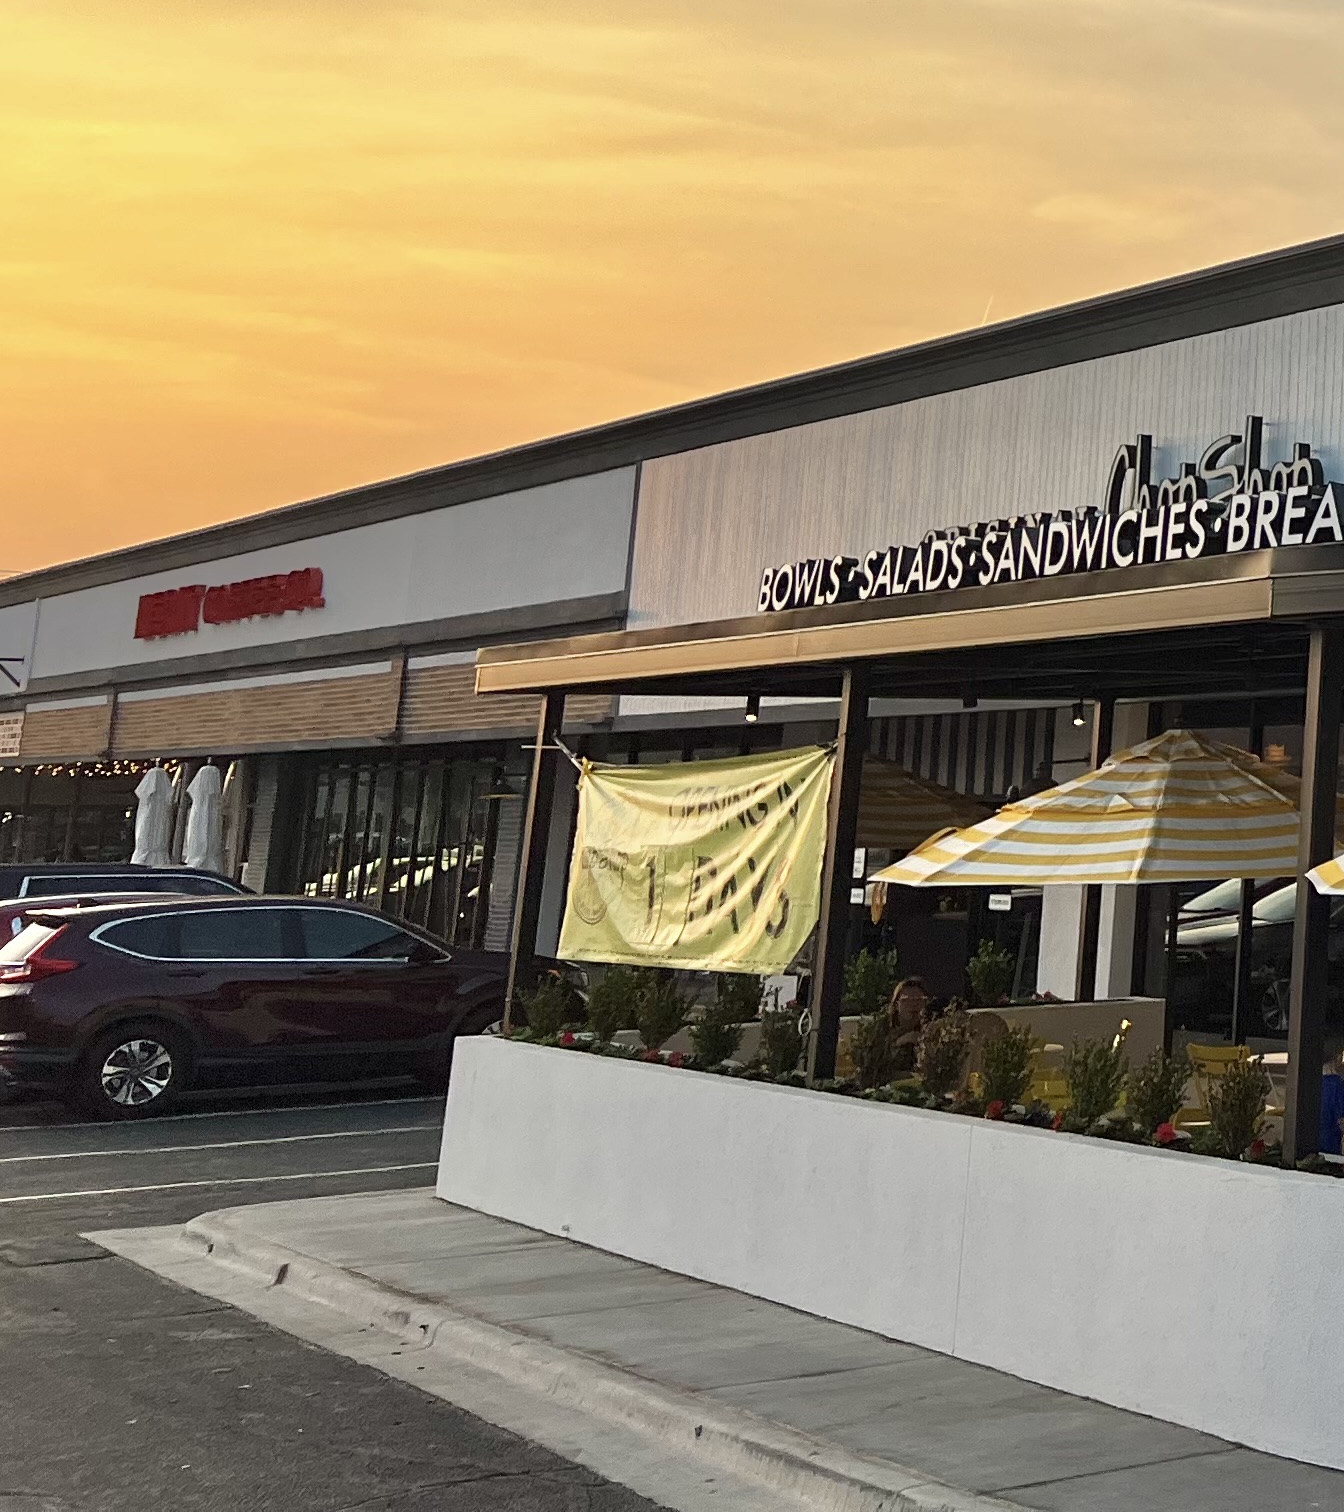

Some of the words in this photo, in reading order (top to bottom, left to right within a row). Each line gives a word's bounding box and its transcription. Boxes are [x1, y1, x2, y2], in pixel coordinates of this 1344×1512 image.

[757, 554, 846, 613] BOWLS
[859, 536, 966, 600] SALADS
[978, 498, 1209, 586] SANDWICHES
